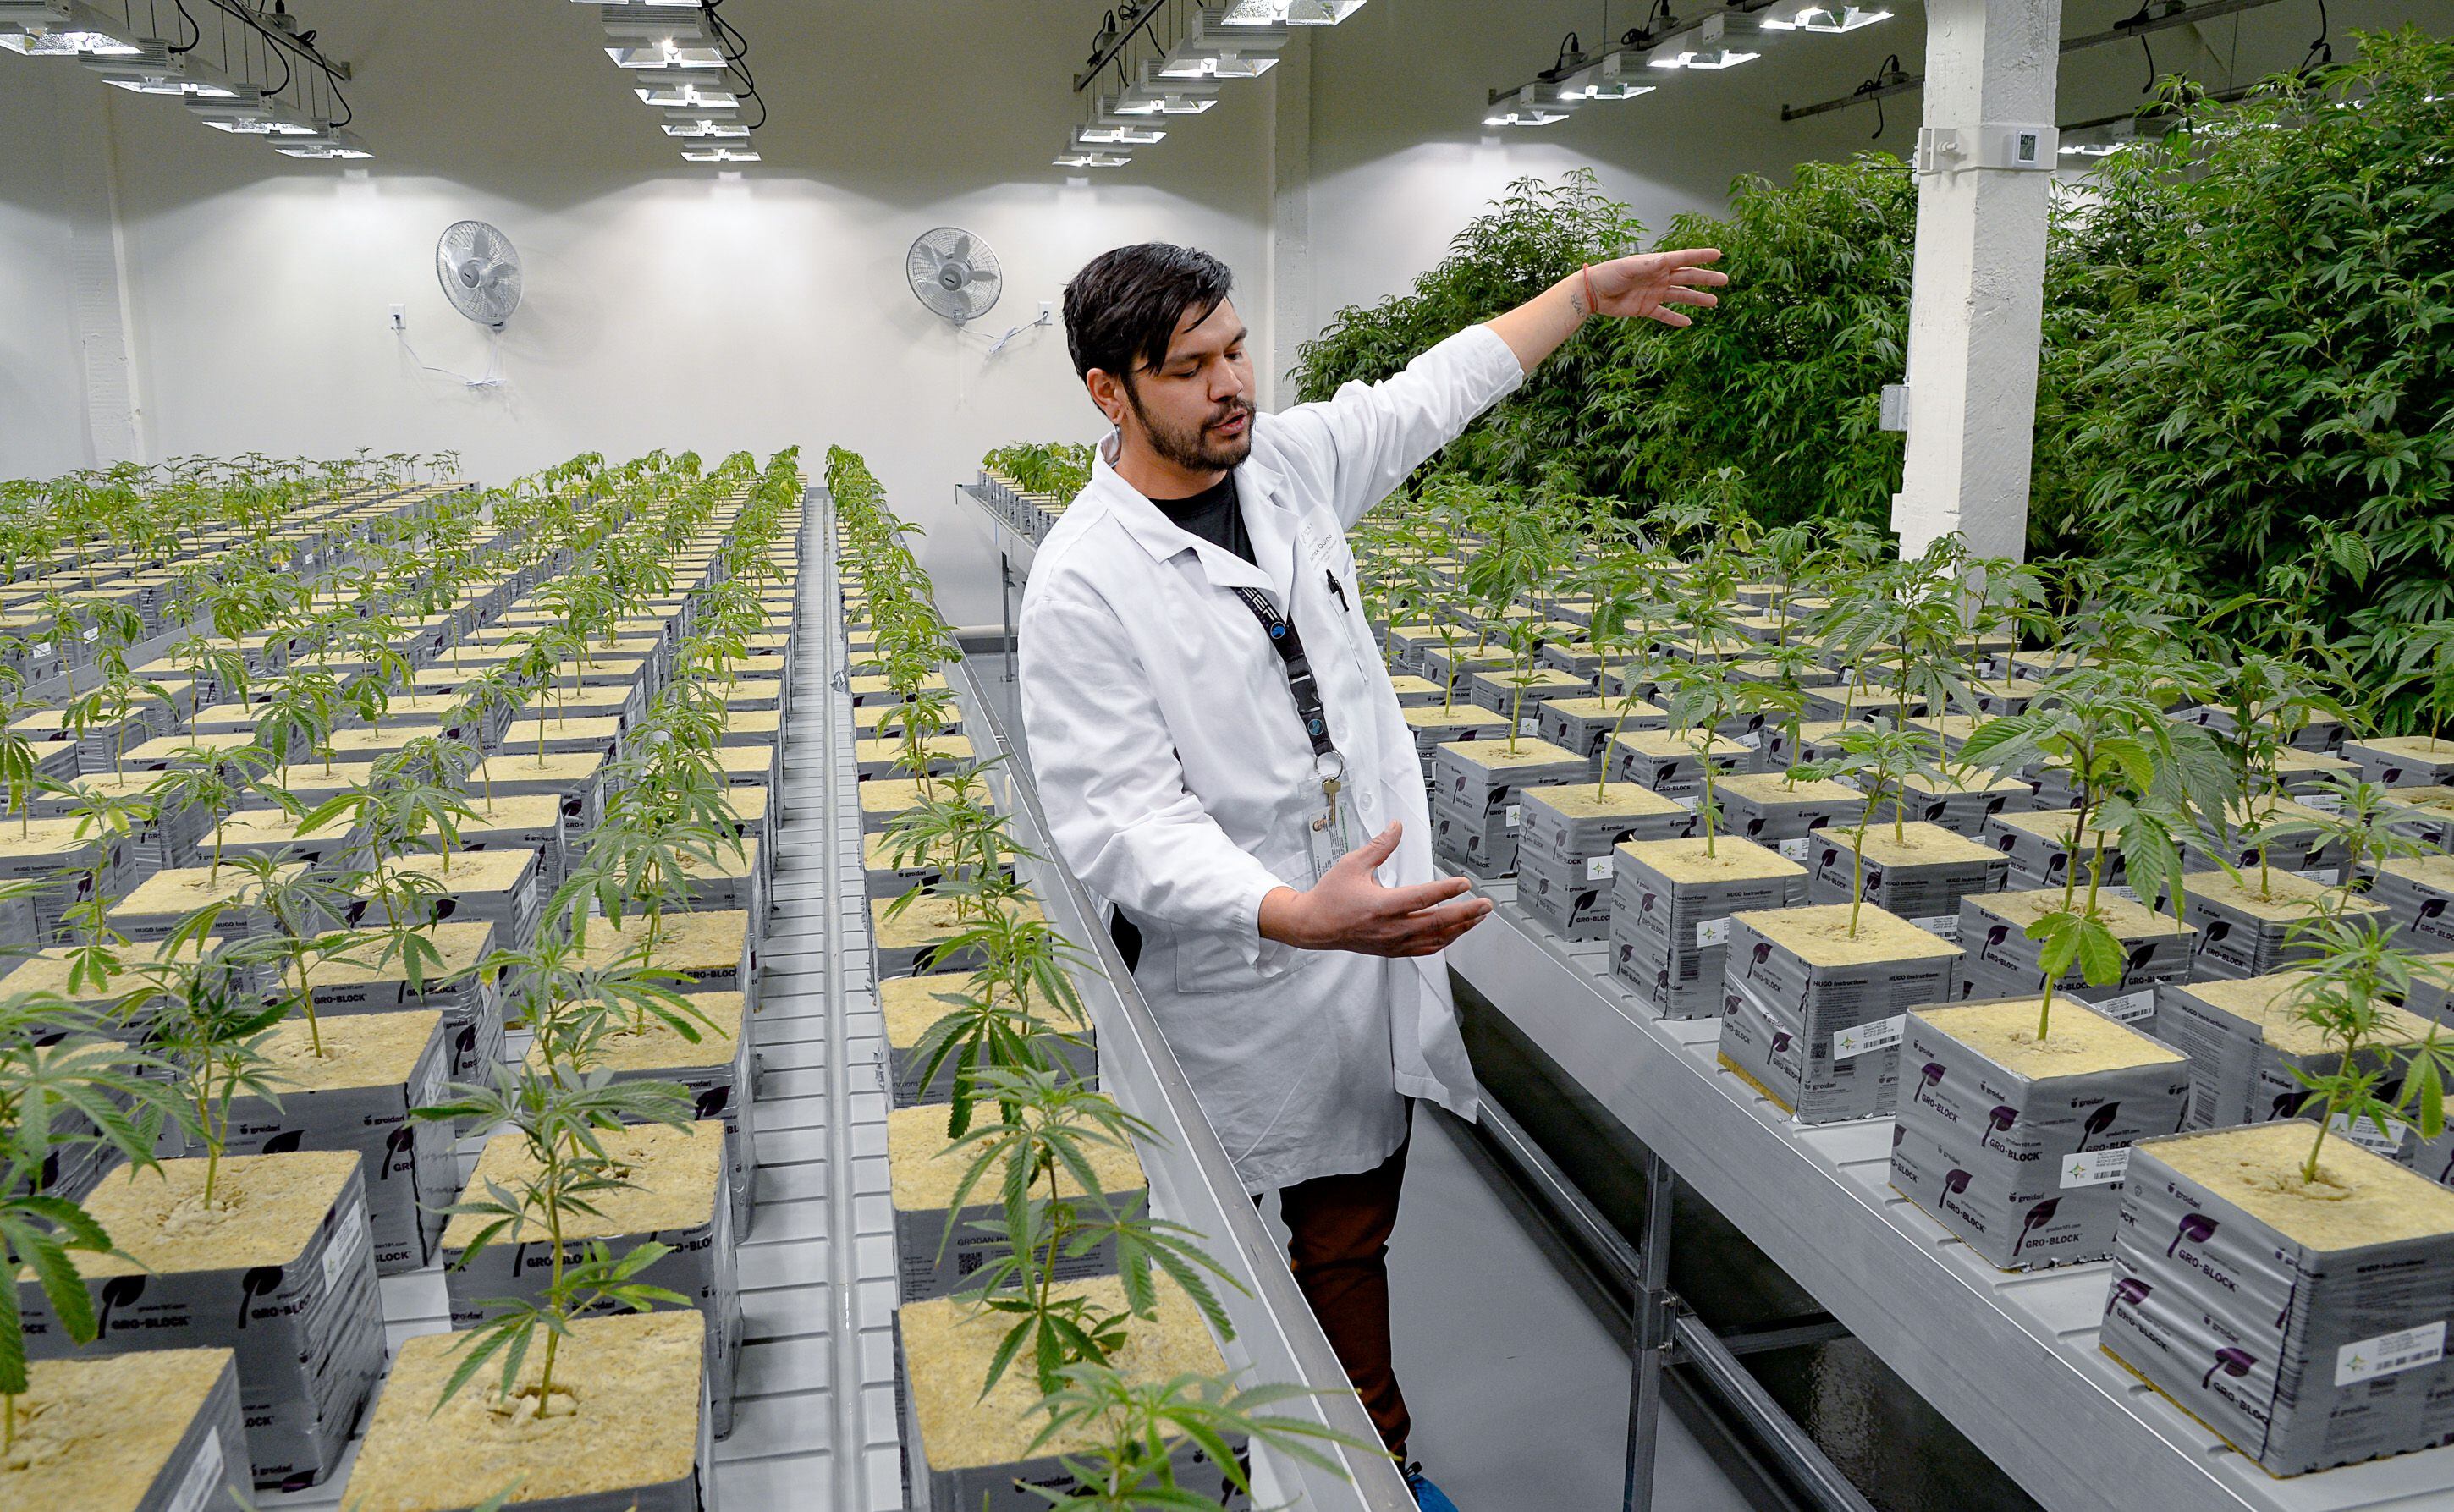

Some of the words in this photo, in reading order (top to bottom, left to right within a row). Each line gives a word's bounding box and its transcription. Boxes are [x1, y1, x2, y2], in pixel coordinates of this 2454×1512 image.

[314, 993, 367, 1004] GRO-BLOCK
[2025, 1233, 2083, 1249] GRO-BLOCK
[2177, 1248, 2237, 1293] GRO-BLOCK
